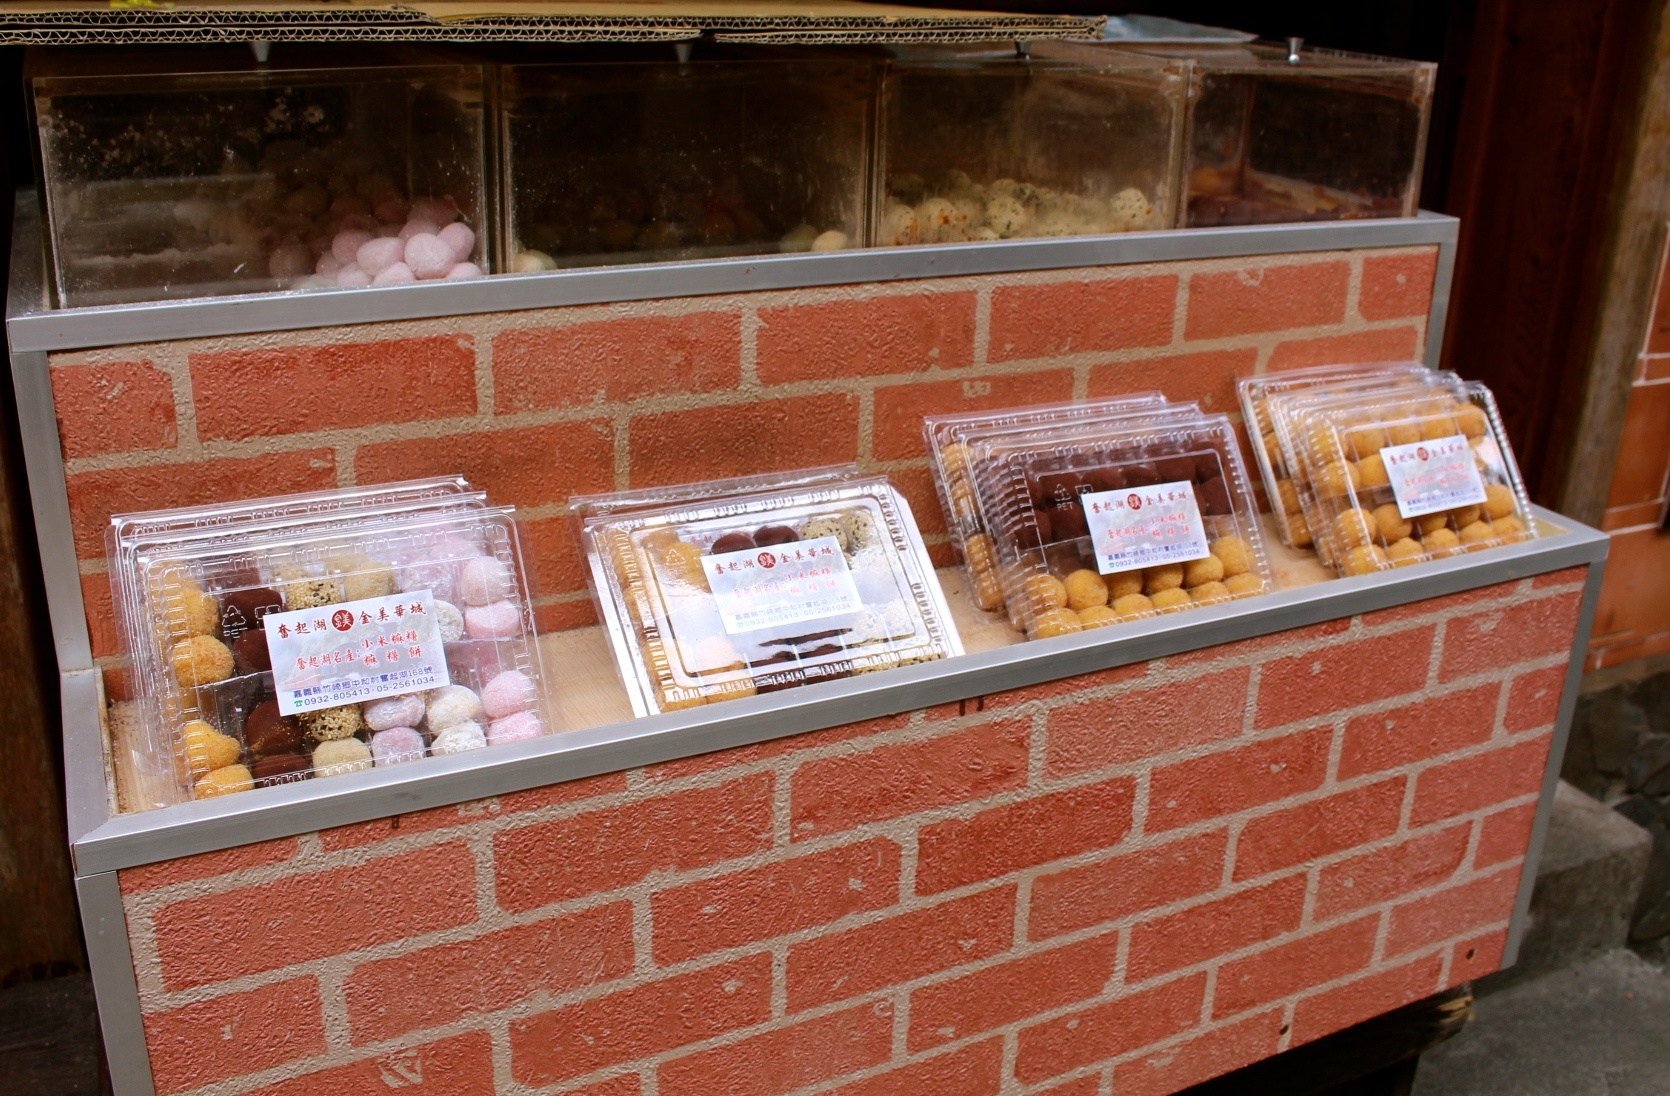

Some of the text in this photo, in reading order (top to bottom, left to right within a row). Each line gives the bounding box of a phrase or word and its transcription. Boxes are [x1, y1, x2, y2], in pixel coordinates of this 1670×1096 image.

[277, 618, 328, 639] 奮起湖
[358, 602, 427, 625] 金美華城
[304, 676, 435, 706] 0932-805413 05-2561034
